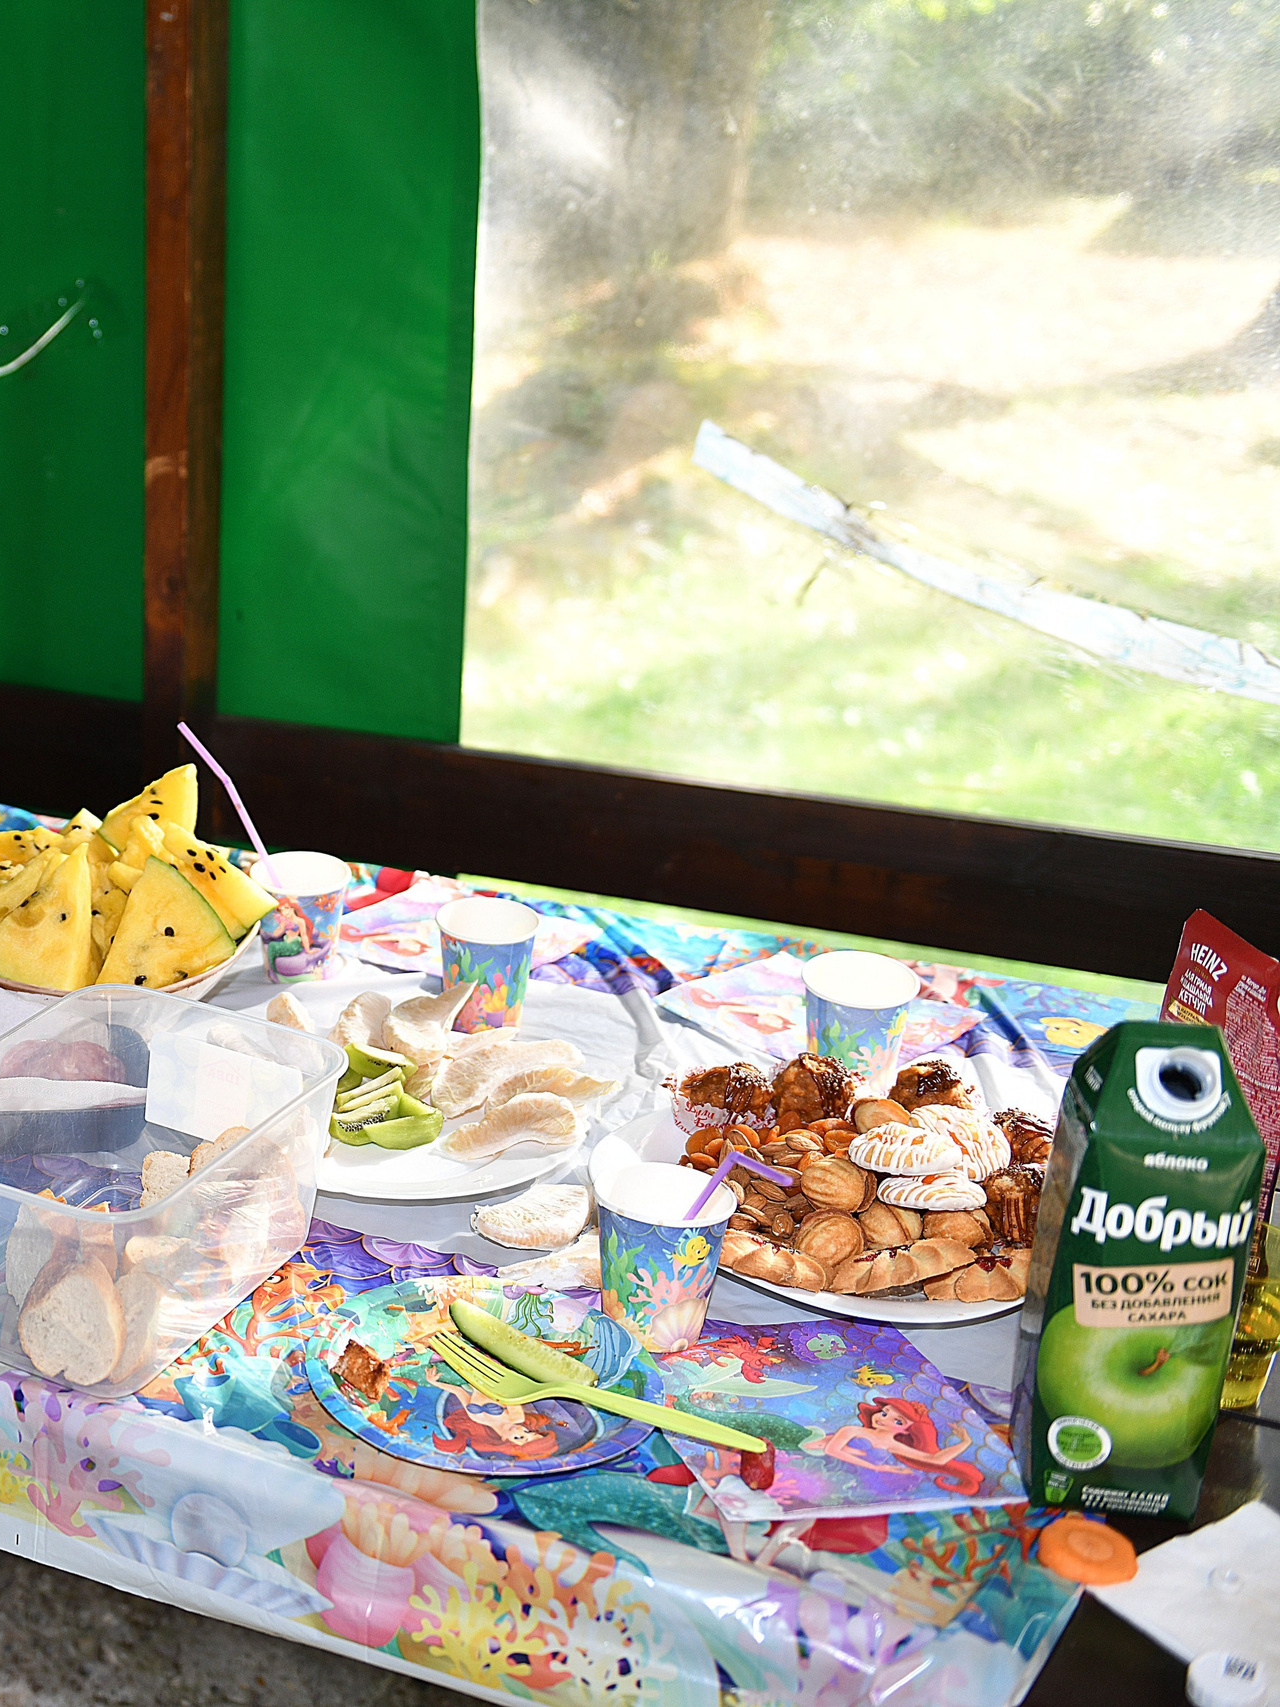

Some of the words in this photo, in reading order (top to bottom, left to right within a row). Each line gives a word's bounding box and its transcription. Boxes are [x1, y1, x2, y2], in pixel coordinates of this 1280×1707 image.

[1190, 942, 1228, 983] HEINZ
[1182, 977, 1214, 1009] ШАШЛЫКА
[1184, 968, 1196, 983] ДЛЯ
[1193, 975, 1213, 997] ГРИЛЯ
[1178, 987, 1207, 1016] КЕТЧУП
[1143, 1151, 1209, 1172] яблоко
[1071, 1187, 1254, 1252] Добрый
[1080, 1269, 1175, 1296] 100%
[1091, 1298, 1117, 1309] БЕЗ
[1120, 1292, 1221, 1311] ДОБАВЛЕНИЯ
[1127, 1311, 1187, 1323] САХАРА
